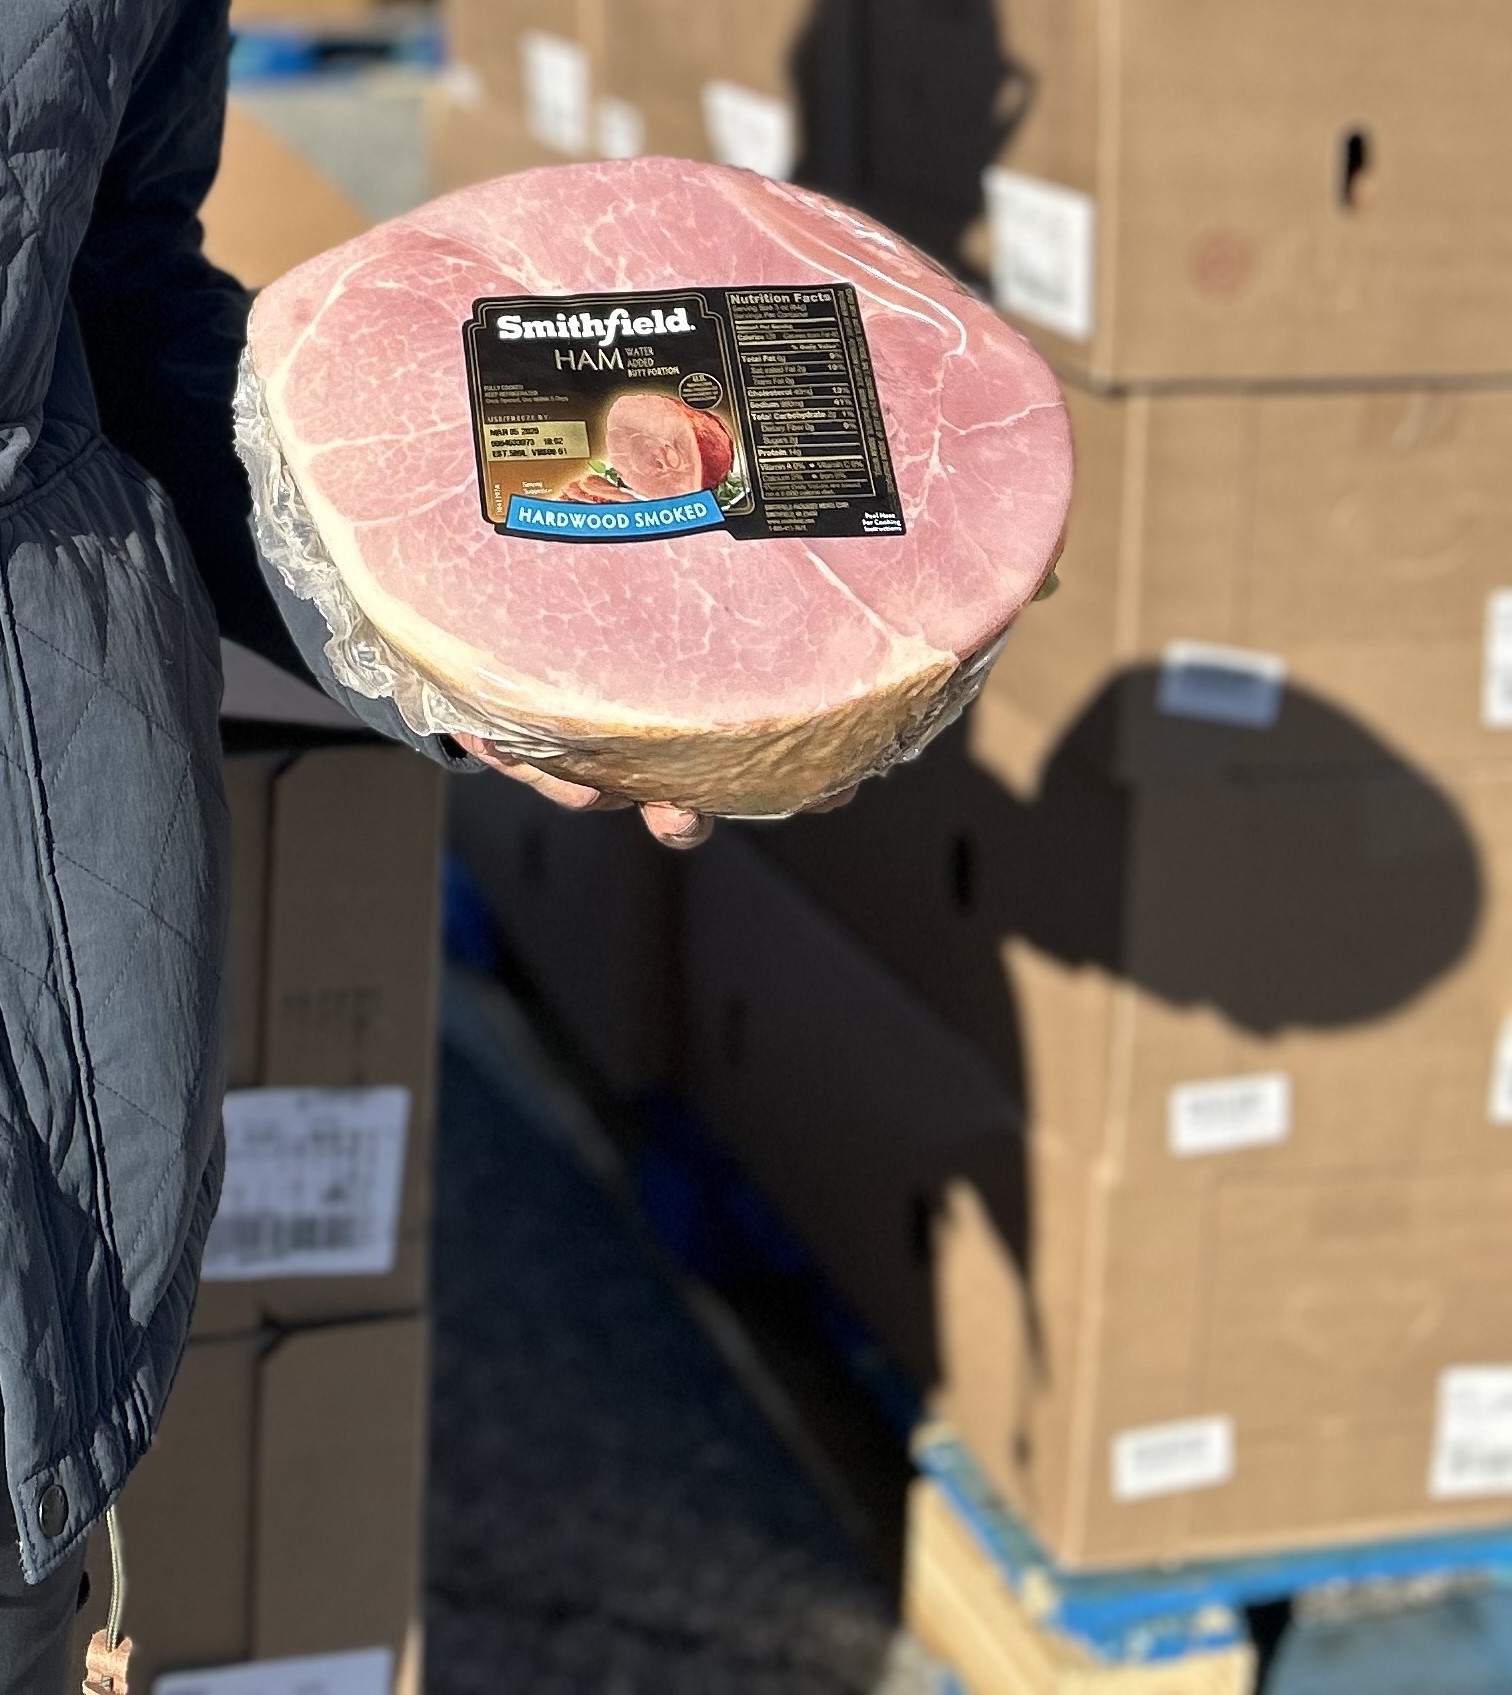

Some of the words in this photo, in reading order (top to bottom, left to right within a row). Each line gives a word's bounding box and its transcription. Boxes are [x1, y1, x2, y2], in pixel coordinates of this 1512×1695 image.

[729, 293, 791, 304] Nutrition
[793, 292, 832, 303] Facts
[625, 346, 654, 357] WATER
[554, 348, 624, 371] HAM
[627, 358, 654, 368] ADDED
[741, 355, 762, 363] Total
[763, 354, 776, 362] Fat
[628, 368, 646, 378] BUTT
[648, 366, 680, 377] PORTION
[748, 388, 792, 397] Cholesterol
[749, 401, 779, 409] Sodium
[751, 412, 772, 420] Total
[773, 411, 826, 420] Carbohydrate
[757, 448, 788, 457] Protein
[518, 506, 630, 529] HARDWOOD
[634, 503, 707, 527] SMOKED
